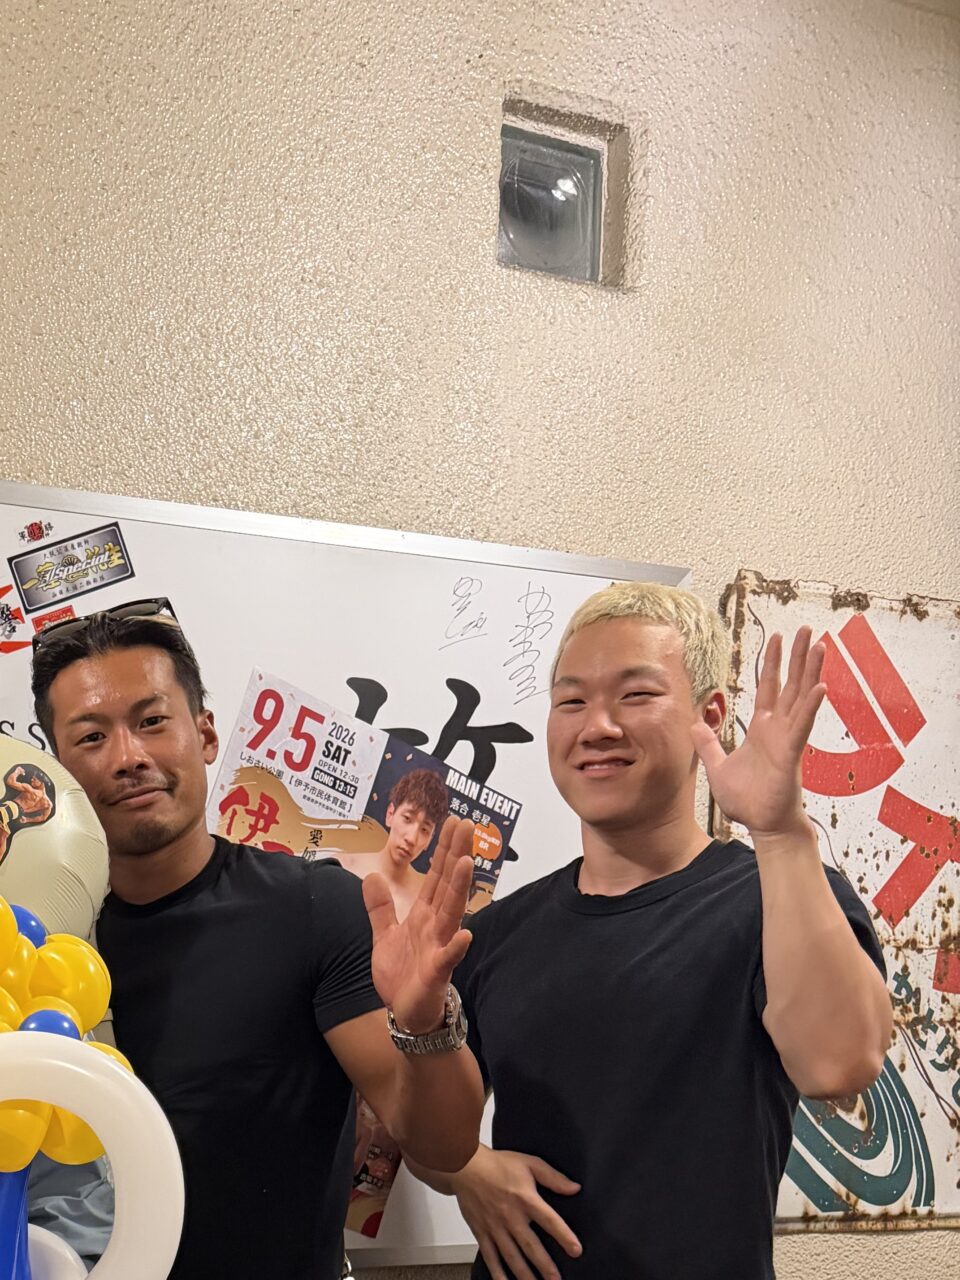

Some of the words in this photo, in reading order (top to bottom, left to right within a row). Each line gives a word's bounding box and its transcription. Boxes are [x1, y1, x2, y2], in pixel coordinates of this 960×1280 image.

[246, 688, 326, 773] 9.5
[328, 722, 357, 748] 2026
[321, 740, 352, 767] SAT
[313, 769, 334, 786] GONG
[334, 778, 356, 798] 13:15
[318, 758, 338, 775] OPEN
[339, 768, 360, 785] 12:30
[445, 768, 480, 801] MAIN
[479, 787, 520, 821] EVENT
